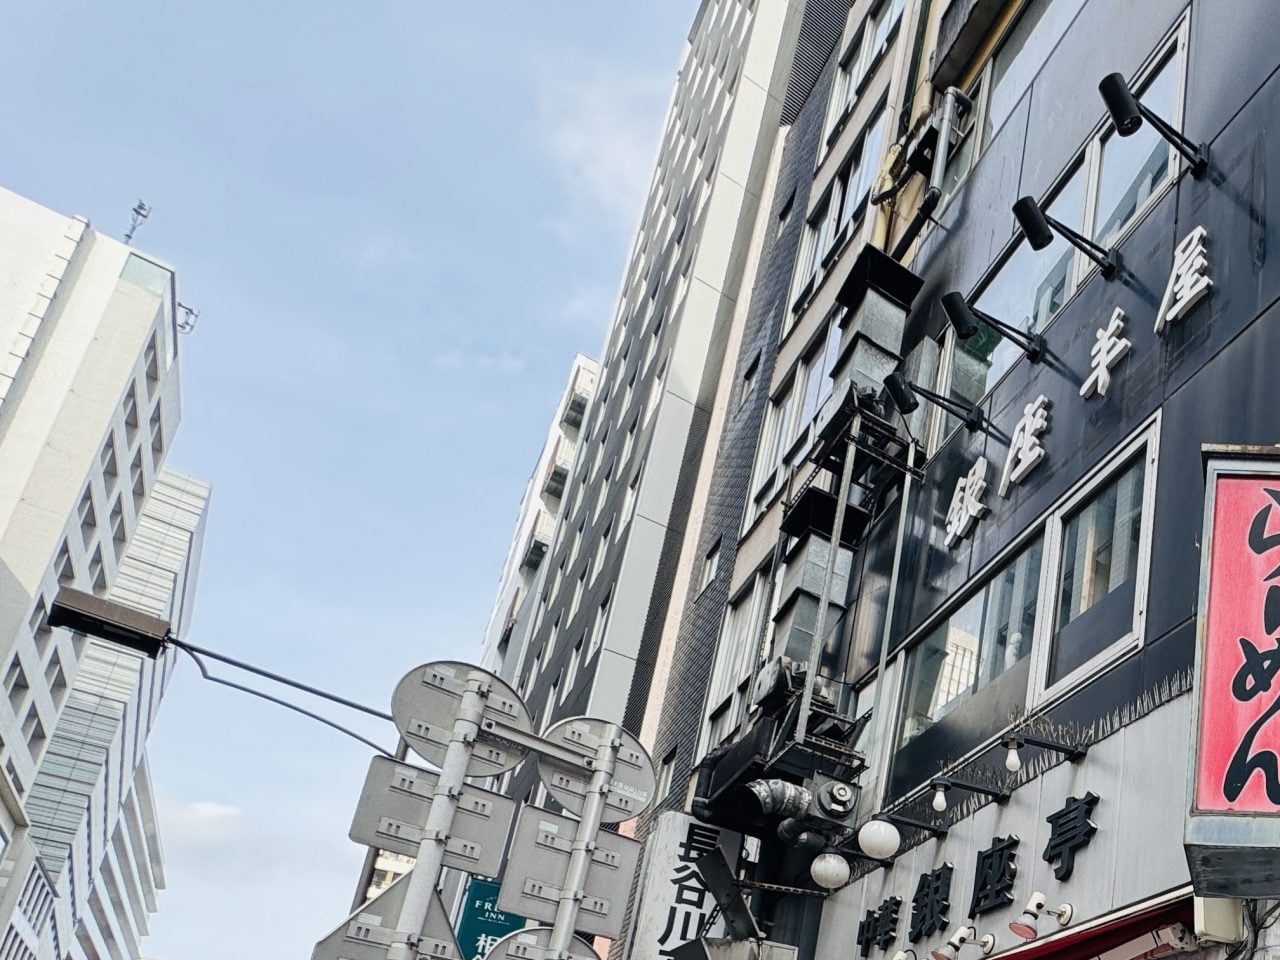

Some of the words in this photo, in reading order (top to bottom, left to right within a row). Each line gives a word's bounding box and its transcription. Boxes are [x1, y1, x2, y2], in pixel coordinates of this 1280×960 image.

[943, 225, 1213, 548] 銀座羊屋
[485, 911, 505, 921] INN
